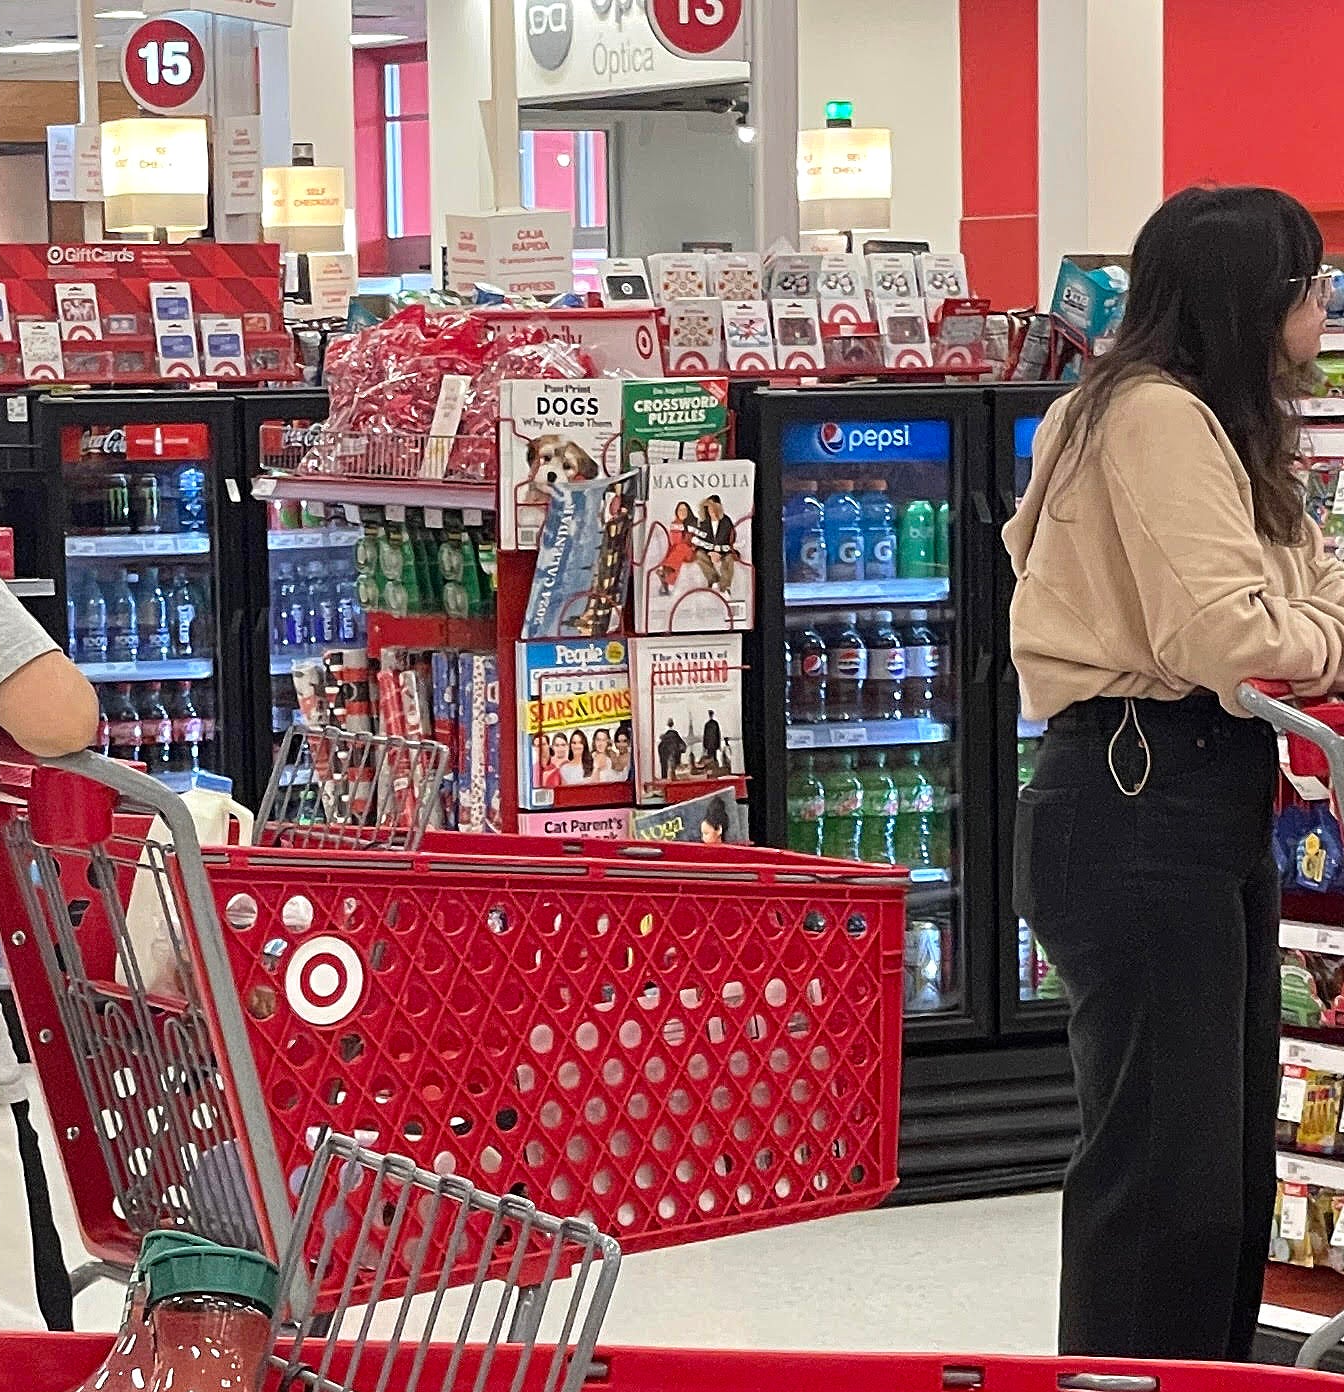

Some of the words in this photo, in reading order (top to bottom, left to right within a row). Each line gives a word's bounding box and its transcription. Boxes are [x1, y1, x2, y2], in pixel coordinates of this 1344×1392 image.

[137, 40, 193, 86] 15
[592, 34, 655, 82] Óptica
[65, 247, 135, 263] GiftCards
[536, 396, 599, 416] DOGS
[633, 395, 719, 413] CROSSWORD
[648, 409, 707, 426] PUZZLES
[848, 424, 911, 452] pepsi
[652, 473, 750, 490] MAGNOLIA
[544, 502, 577, 588] CALENDAR
[555, 644, 603, 668] People
[544, 679, 617, 693] PUZZLER
[589, 690, 631, 715] ICONS
[544, 819, 567, 834] Cat
[570, 817, 623, 834] Parent's
